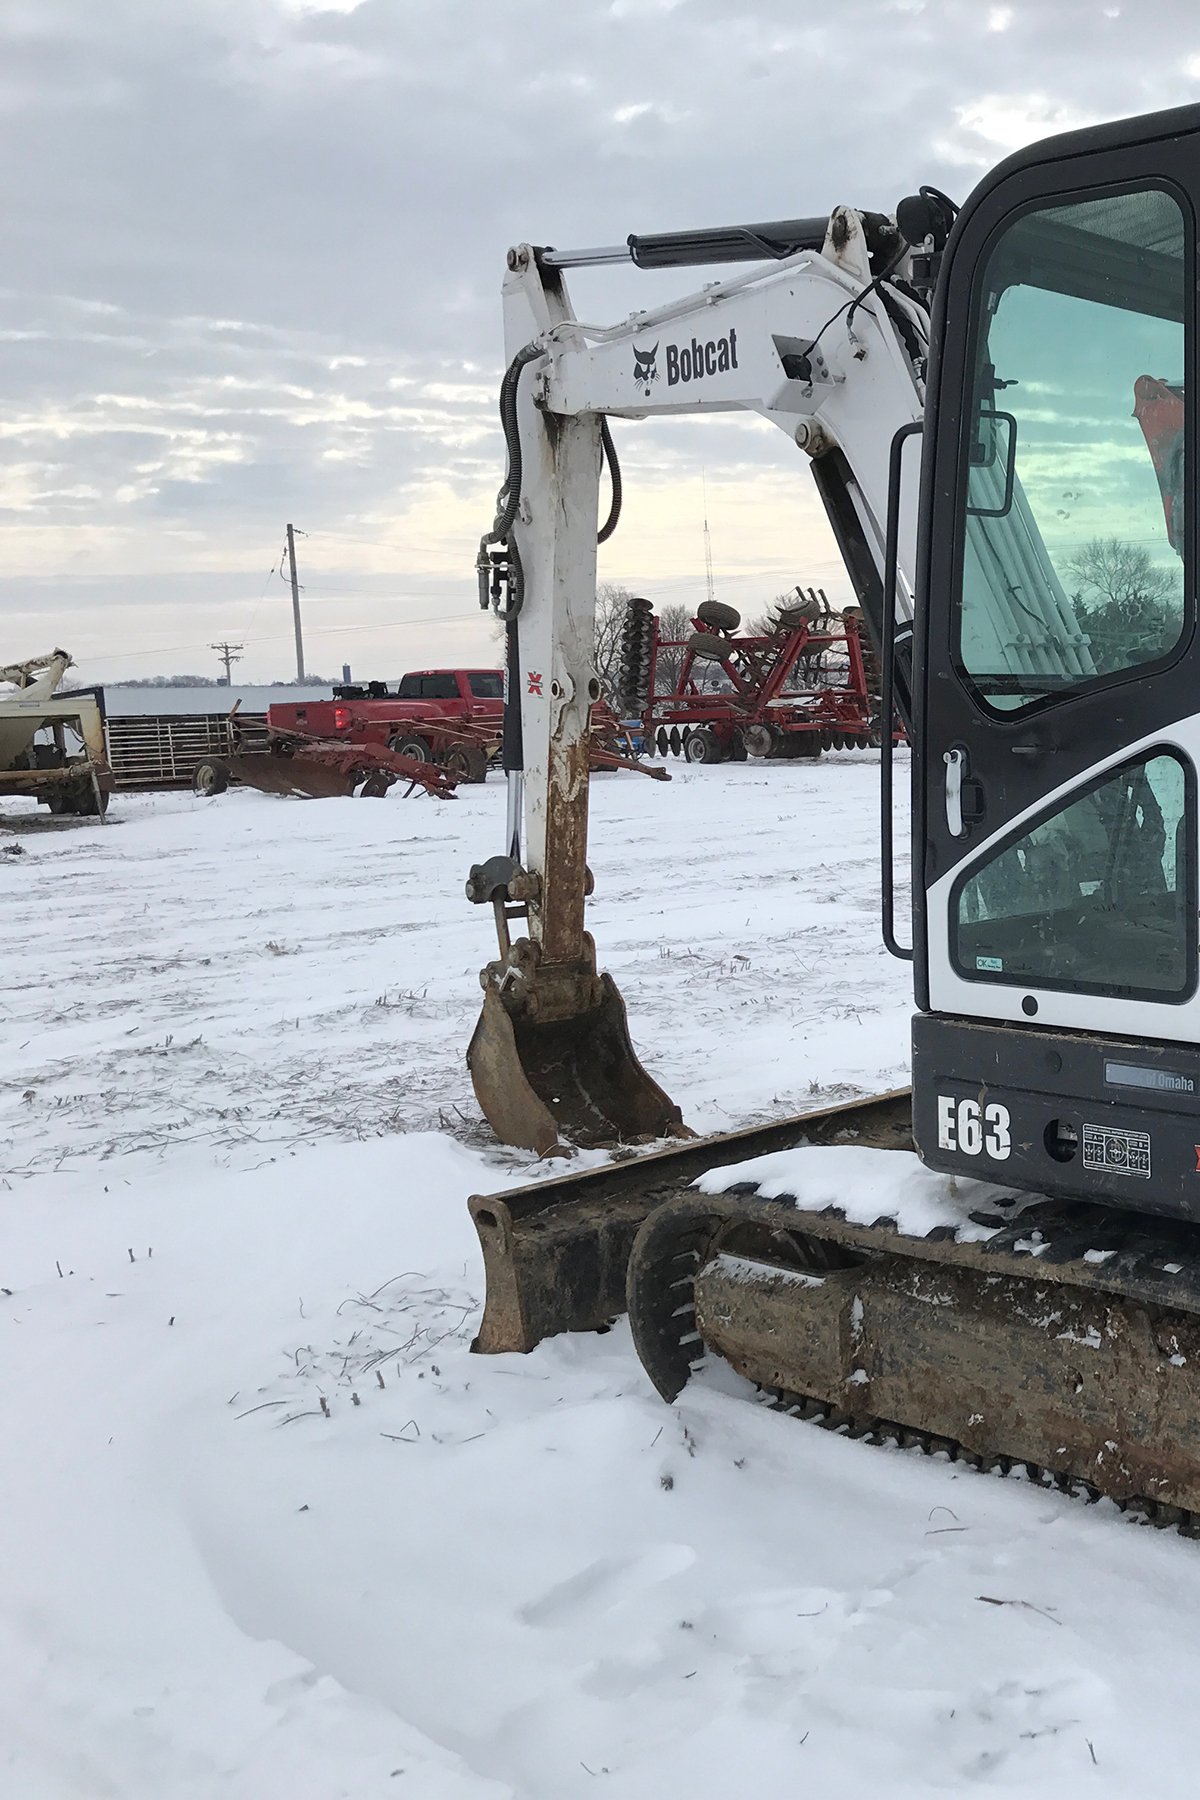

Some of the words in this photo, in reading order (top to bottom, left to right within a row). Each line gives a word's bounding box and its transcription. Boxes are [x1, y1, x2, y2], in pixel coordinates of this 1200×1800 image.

[666, 328, 738, 386] Bobcat
[1158, 1073, 1194, 1092] Omaha
[938, 1095, 1011, 1160] E63
